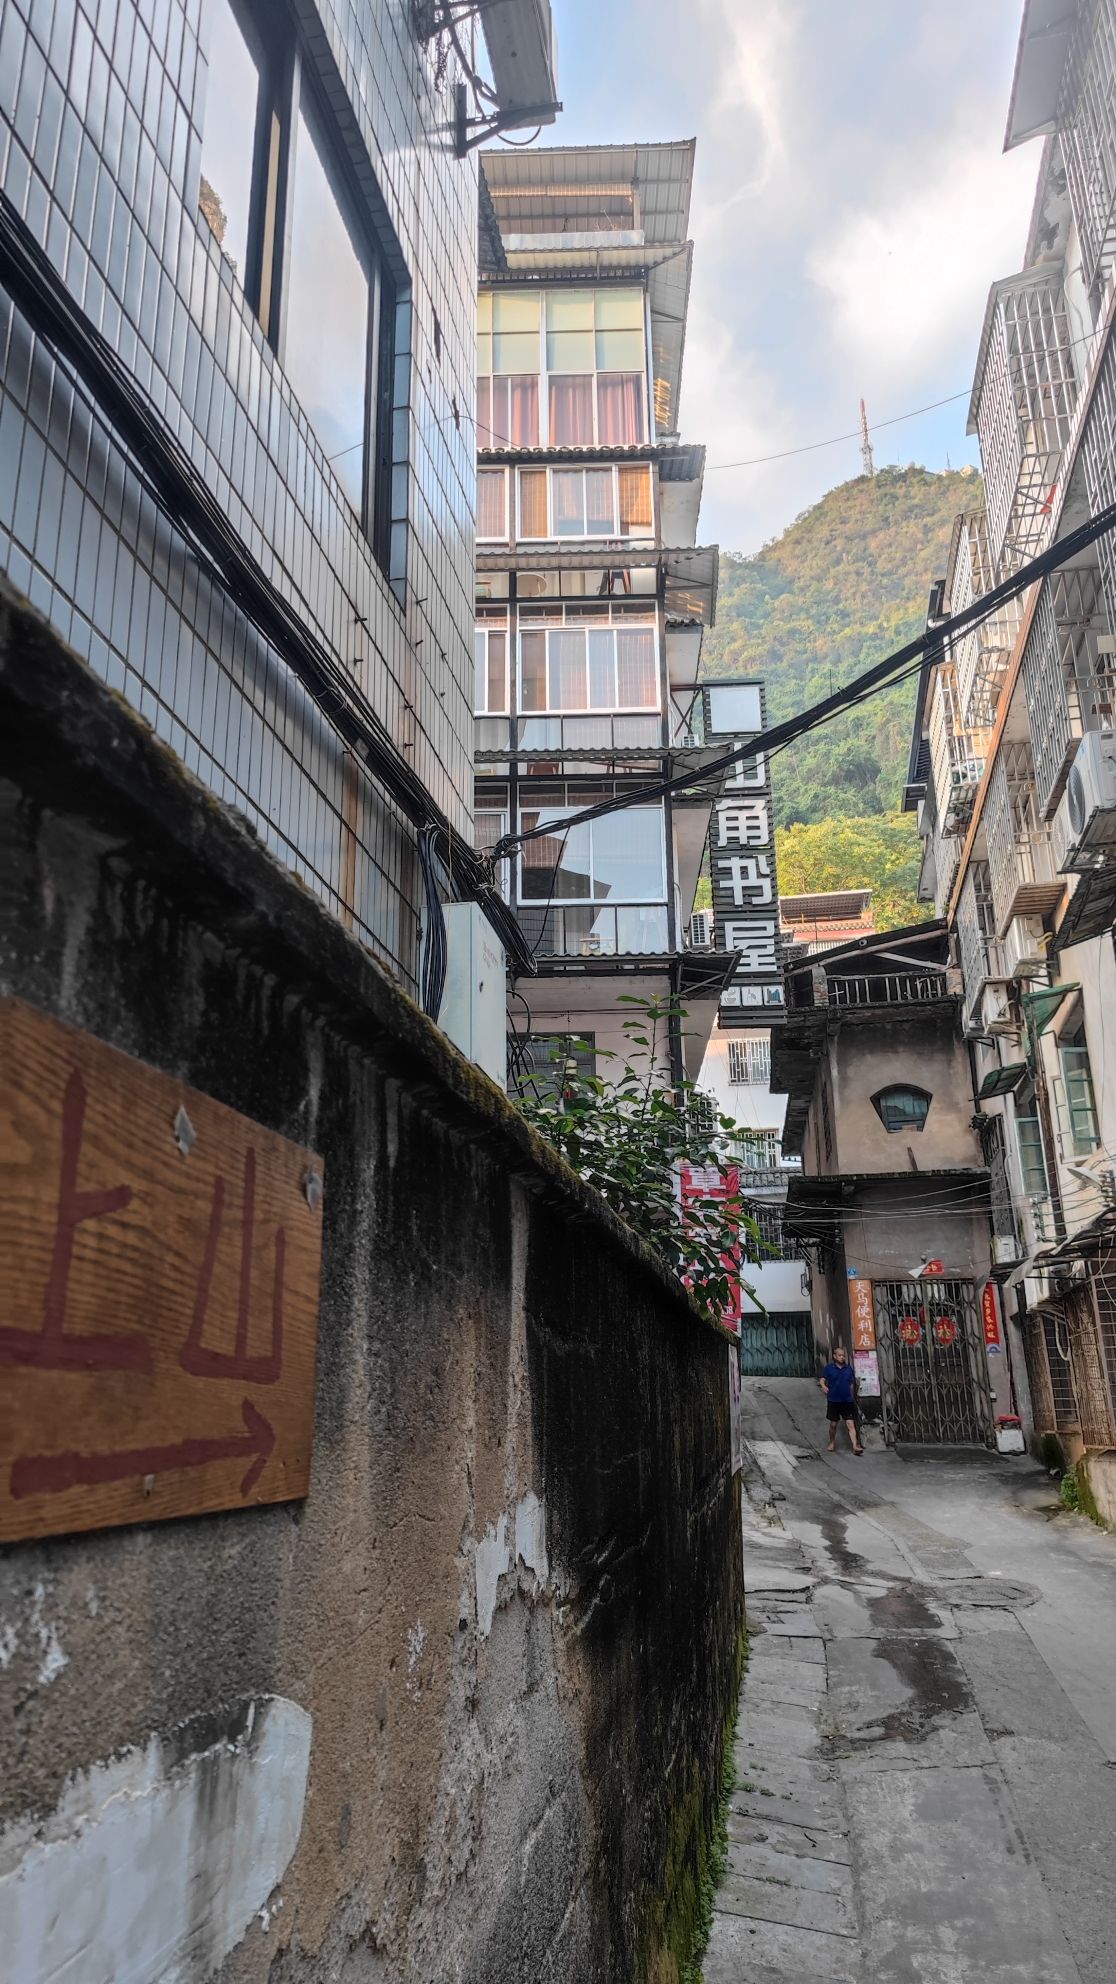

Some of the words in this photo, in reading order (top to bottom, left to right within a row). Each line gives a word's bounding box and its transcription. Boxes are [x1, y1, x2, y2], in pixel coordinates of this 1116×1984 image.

[0, 1067, 284, 1384] 上山
[855, 1281, 872, 1346] 天马便利店
